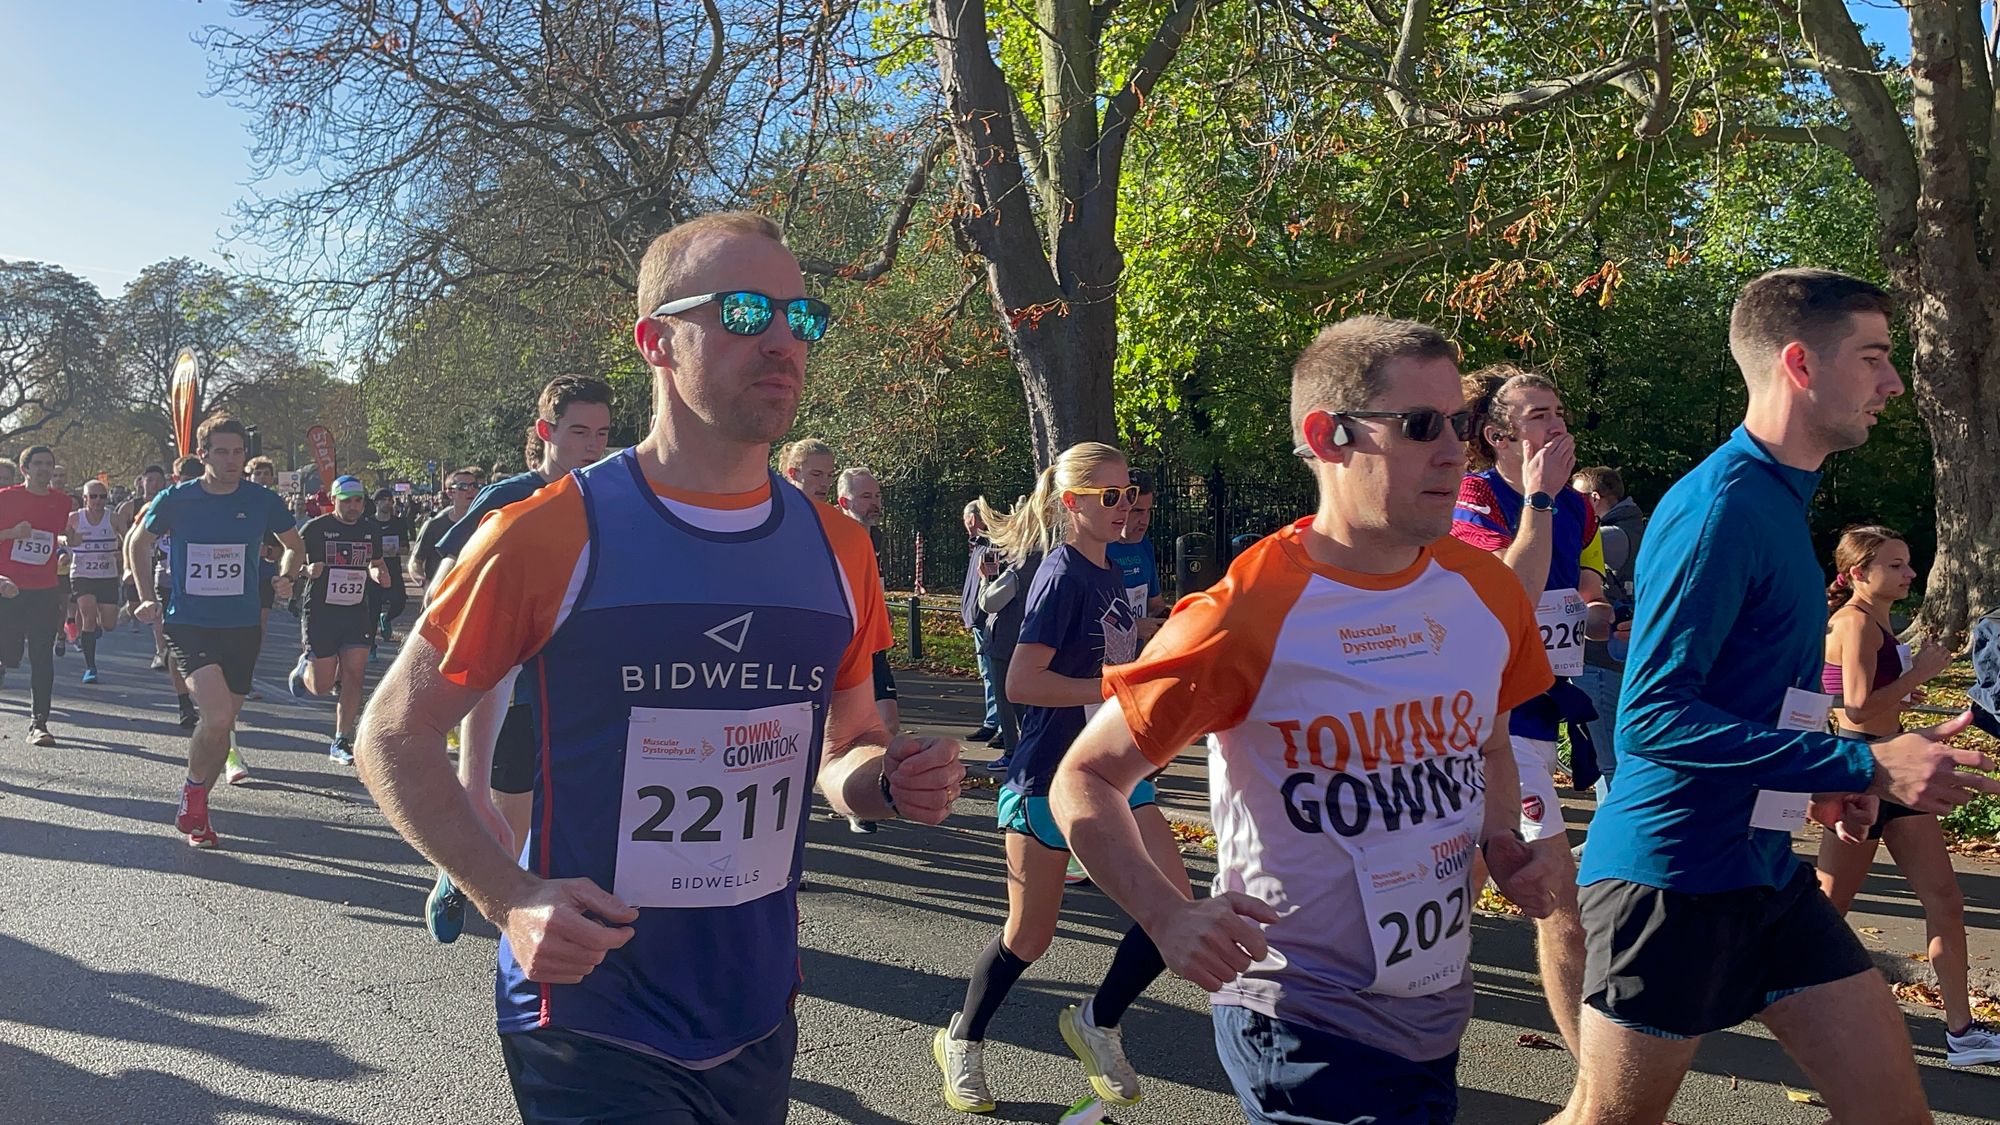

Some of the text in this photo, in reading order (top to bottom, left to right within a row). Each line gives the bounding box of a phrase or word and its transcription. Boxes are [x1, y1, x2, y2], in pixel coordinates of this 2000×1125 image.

[311, 430, 334, 471] Start
[16, 540, 51, 555] 1530
[190, 563, 242, 579] 2159
[331, 583, 363, 594] 1632
[1339, 623, 1397, 641] Muscular
[1343, 631, 1425, 655] Dystrophy UK
[622, 662, 825, 692] BIDWELLS
[724, 719, 782, 747] TOWN&
[1267, 690, 1484, 773] TOWN&
[642, 746, 684, 756] Dystrophy
[723, 733, 799, 768] GOWN10K
[631, 777, 791, 843] 2211
[671, 869, 760, 890] BIDWELLS
[1379, 874, 1472, 967] 202
